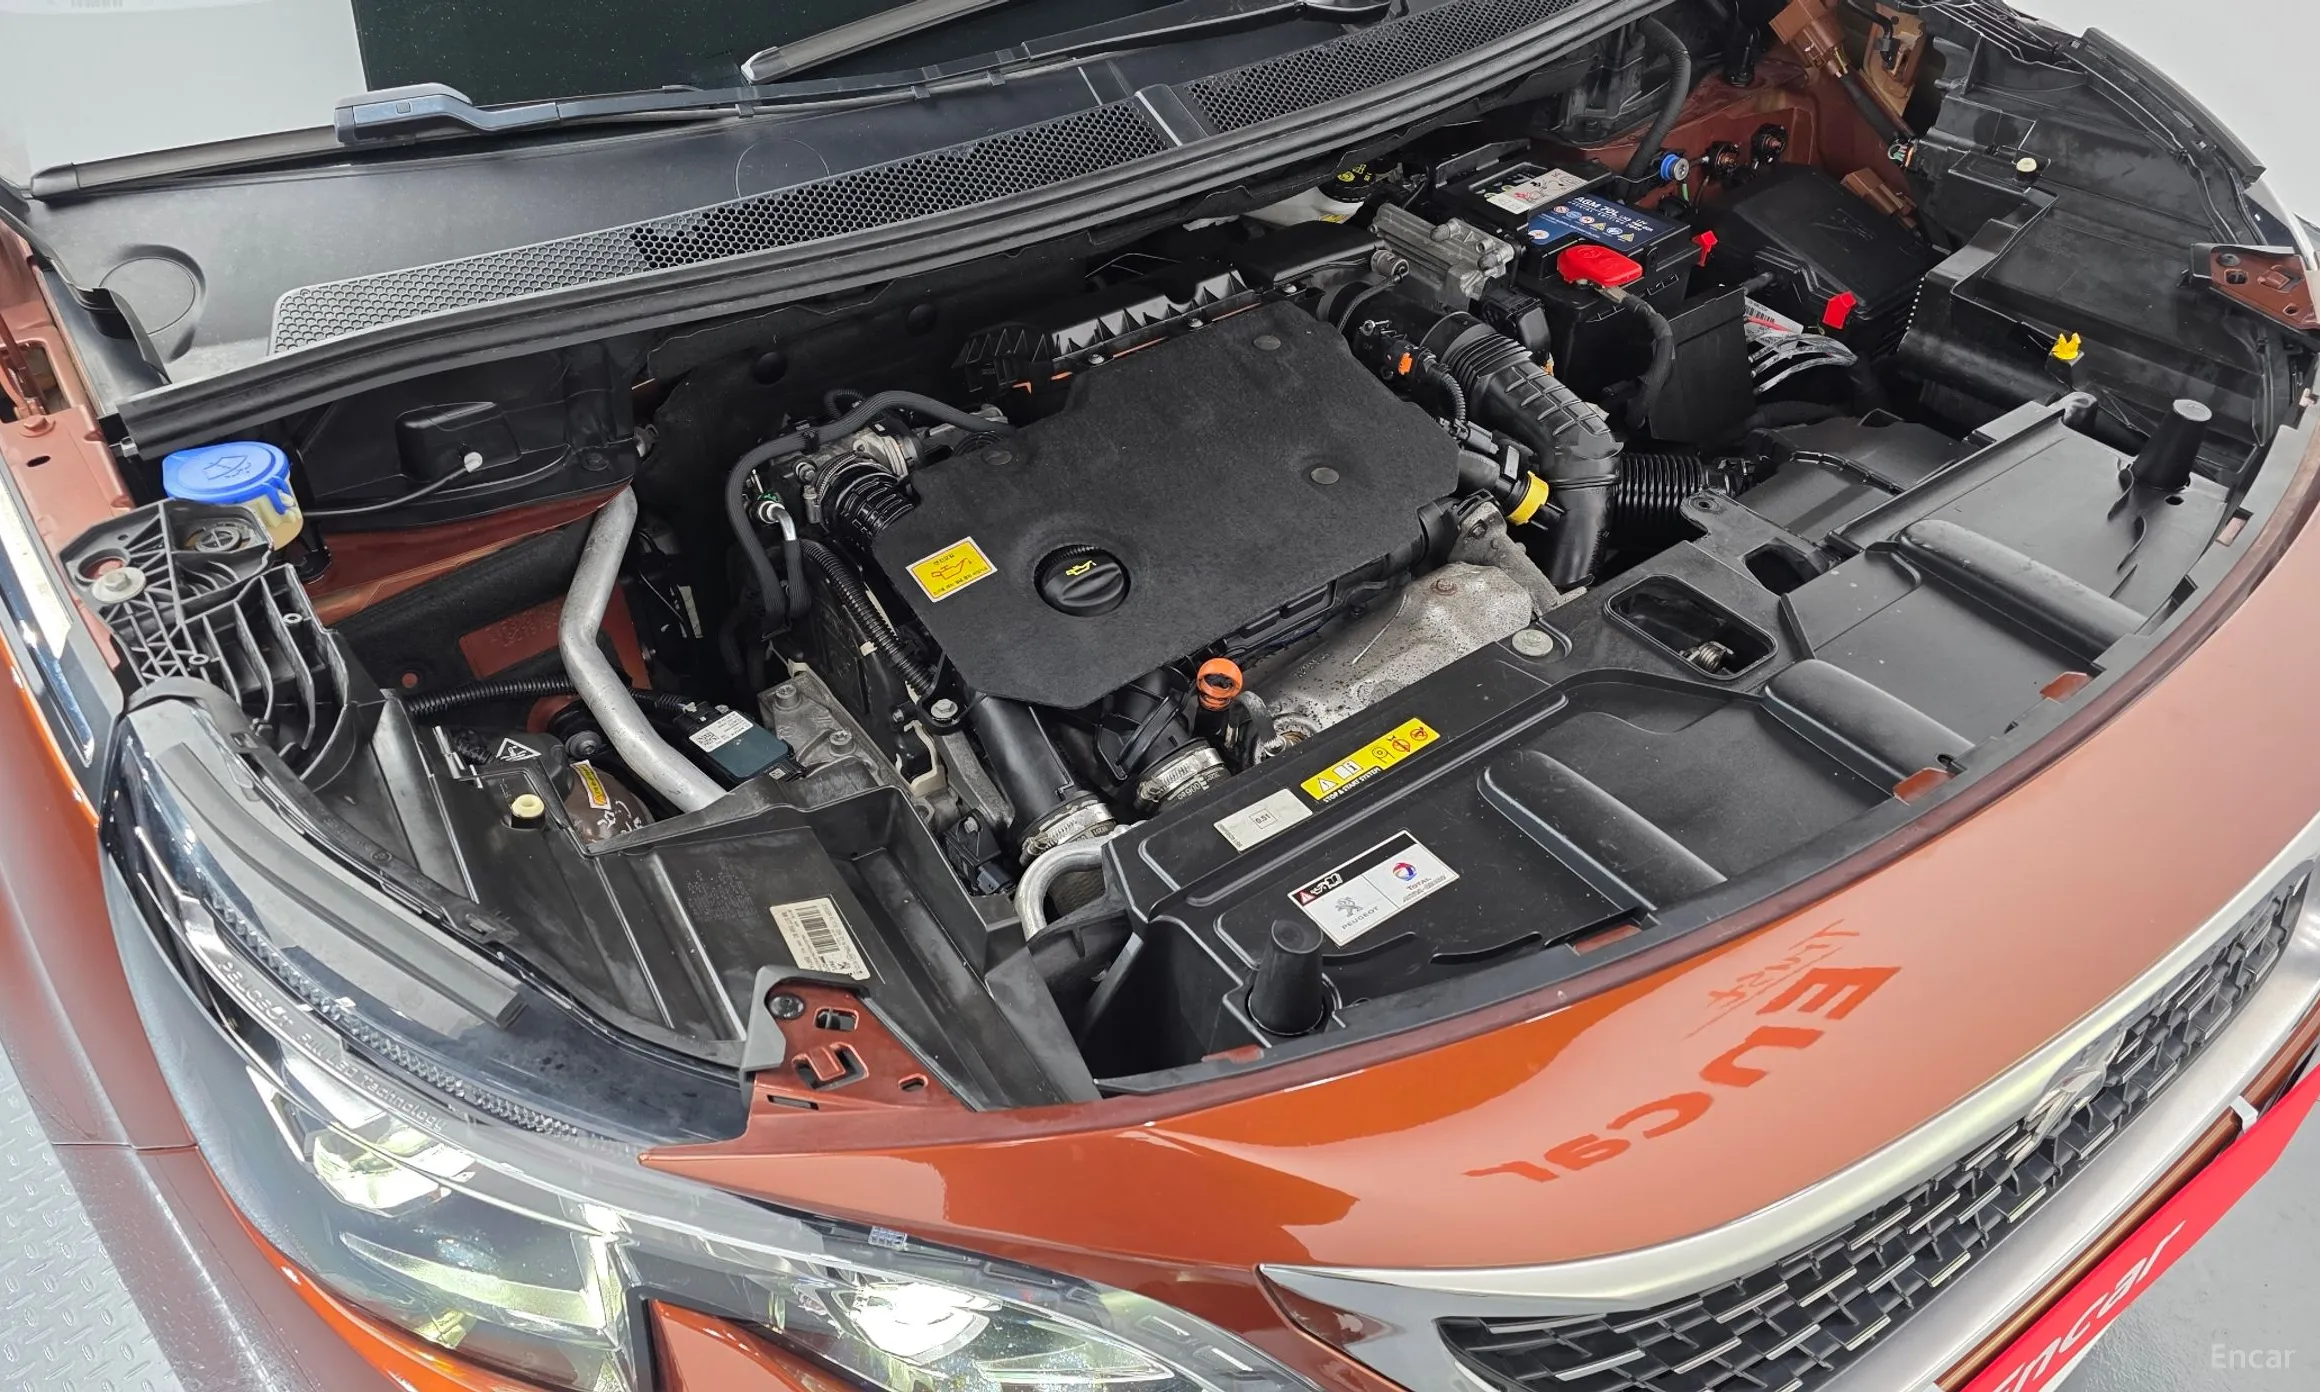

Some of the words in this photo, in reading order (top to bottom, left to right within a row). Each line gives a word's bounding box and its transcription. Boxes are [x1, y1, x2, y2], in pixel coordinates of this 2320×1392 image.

[1323, 791, 1339, 803] STOP
[1342, 778, 1360, 792] START
[1407, 877, 1432, 891] TOTAL
[1341, 905, 1380, 930] PEUGEOT
[217, 961, 294, 1027] PEUGEOT
[325, 1057, 358, 1078] LED
[360, 1074, 448, 1132] Technology
